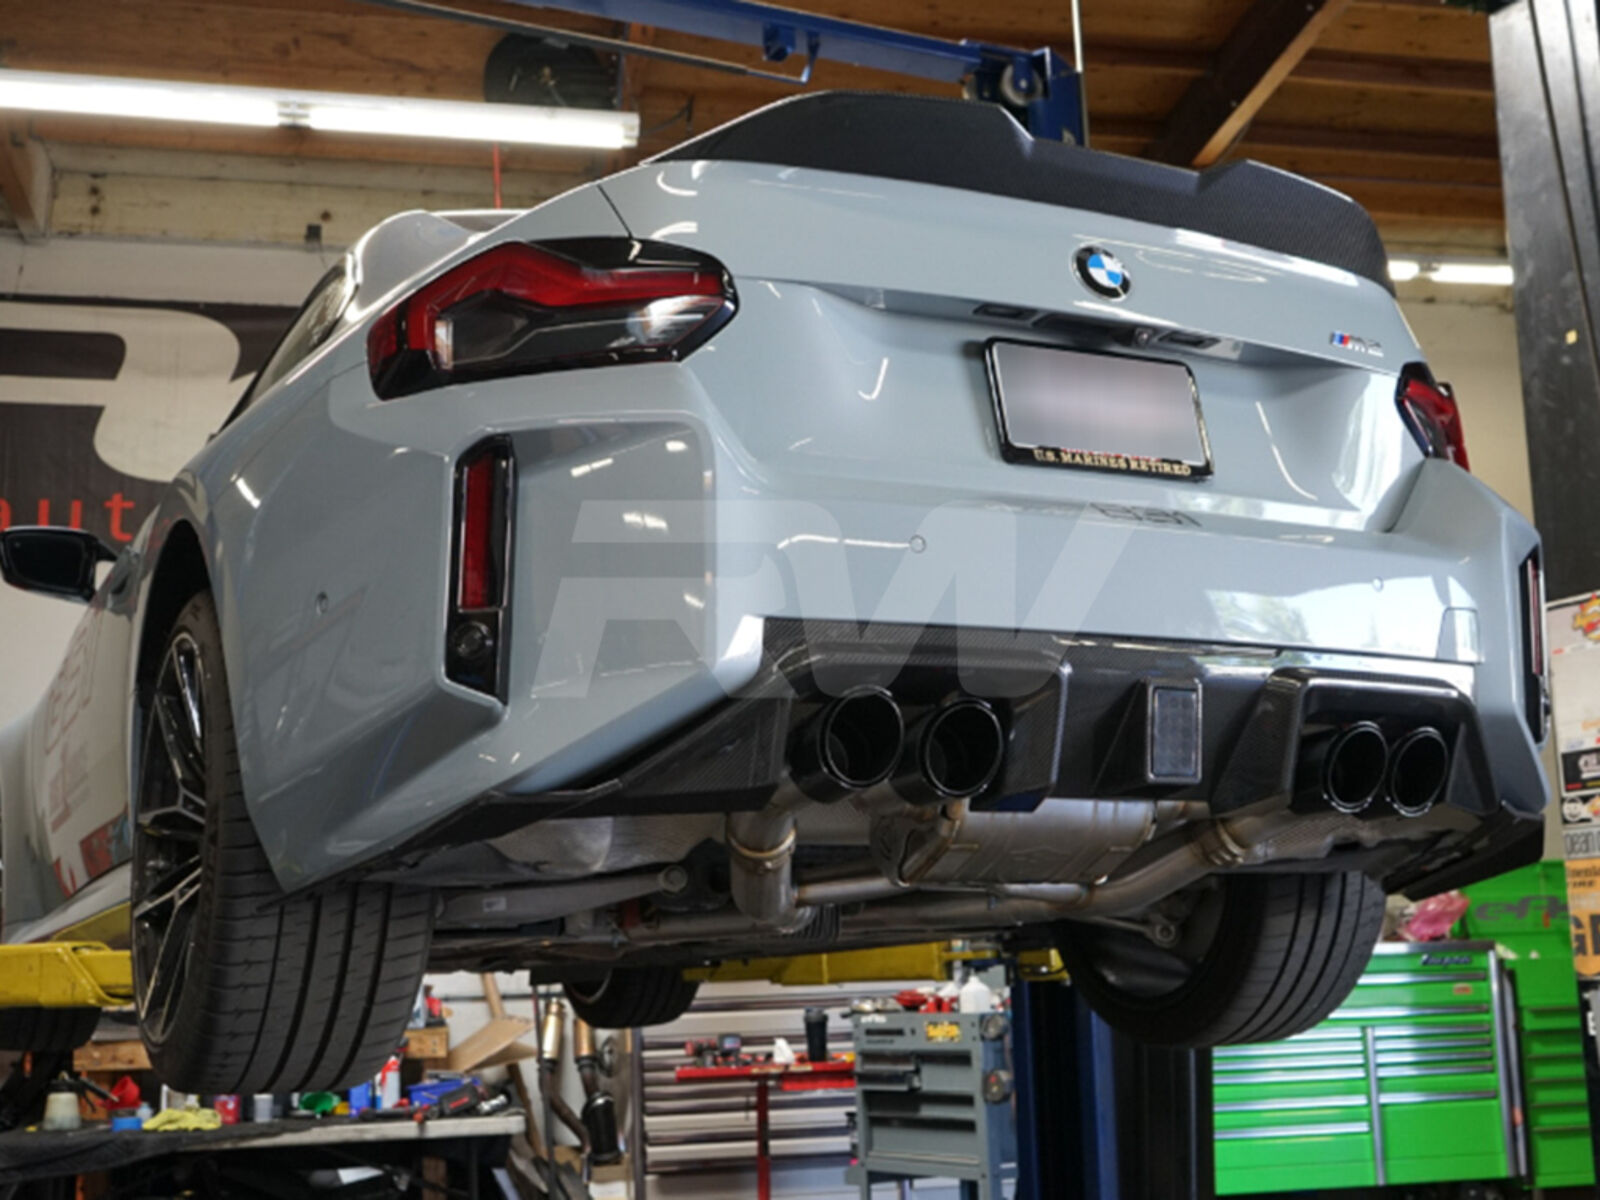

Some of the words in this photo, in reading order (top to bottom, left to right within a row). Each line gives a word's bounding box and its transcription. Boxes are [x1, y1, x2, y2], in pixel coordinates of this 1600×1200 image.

[1033, 448, 1059, 463] U.S.
[1060, 451, 1127, 470] MARINES
[1129, 458, 1192, 477] RETIRED
